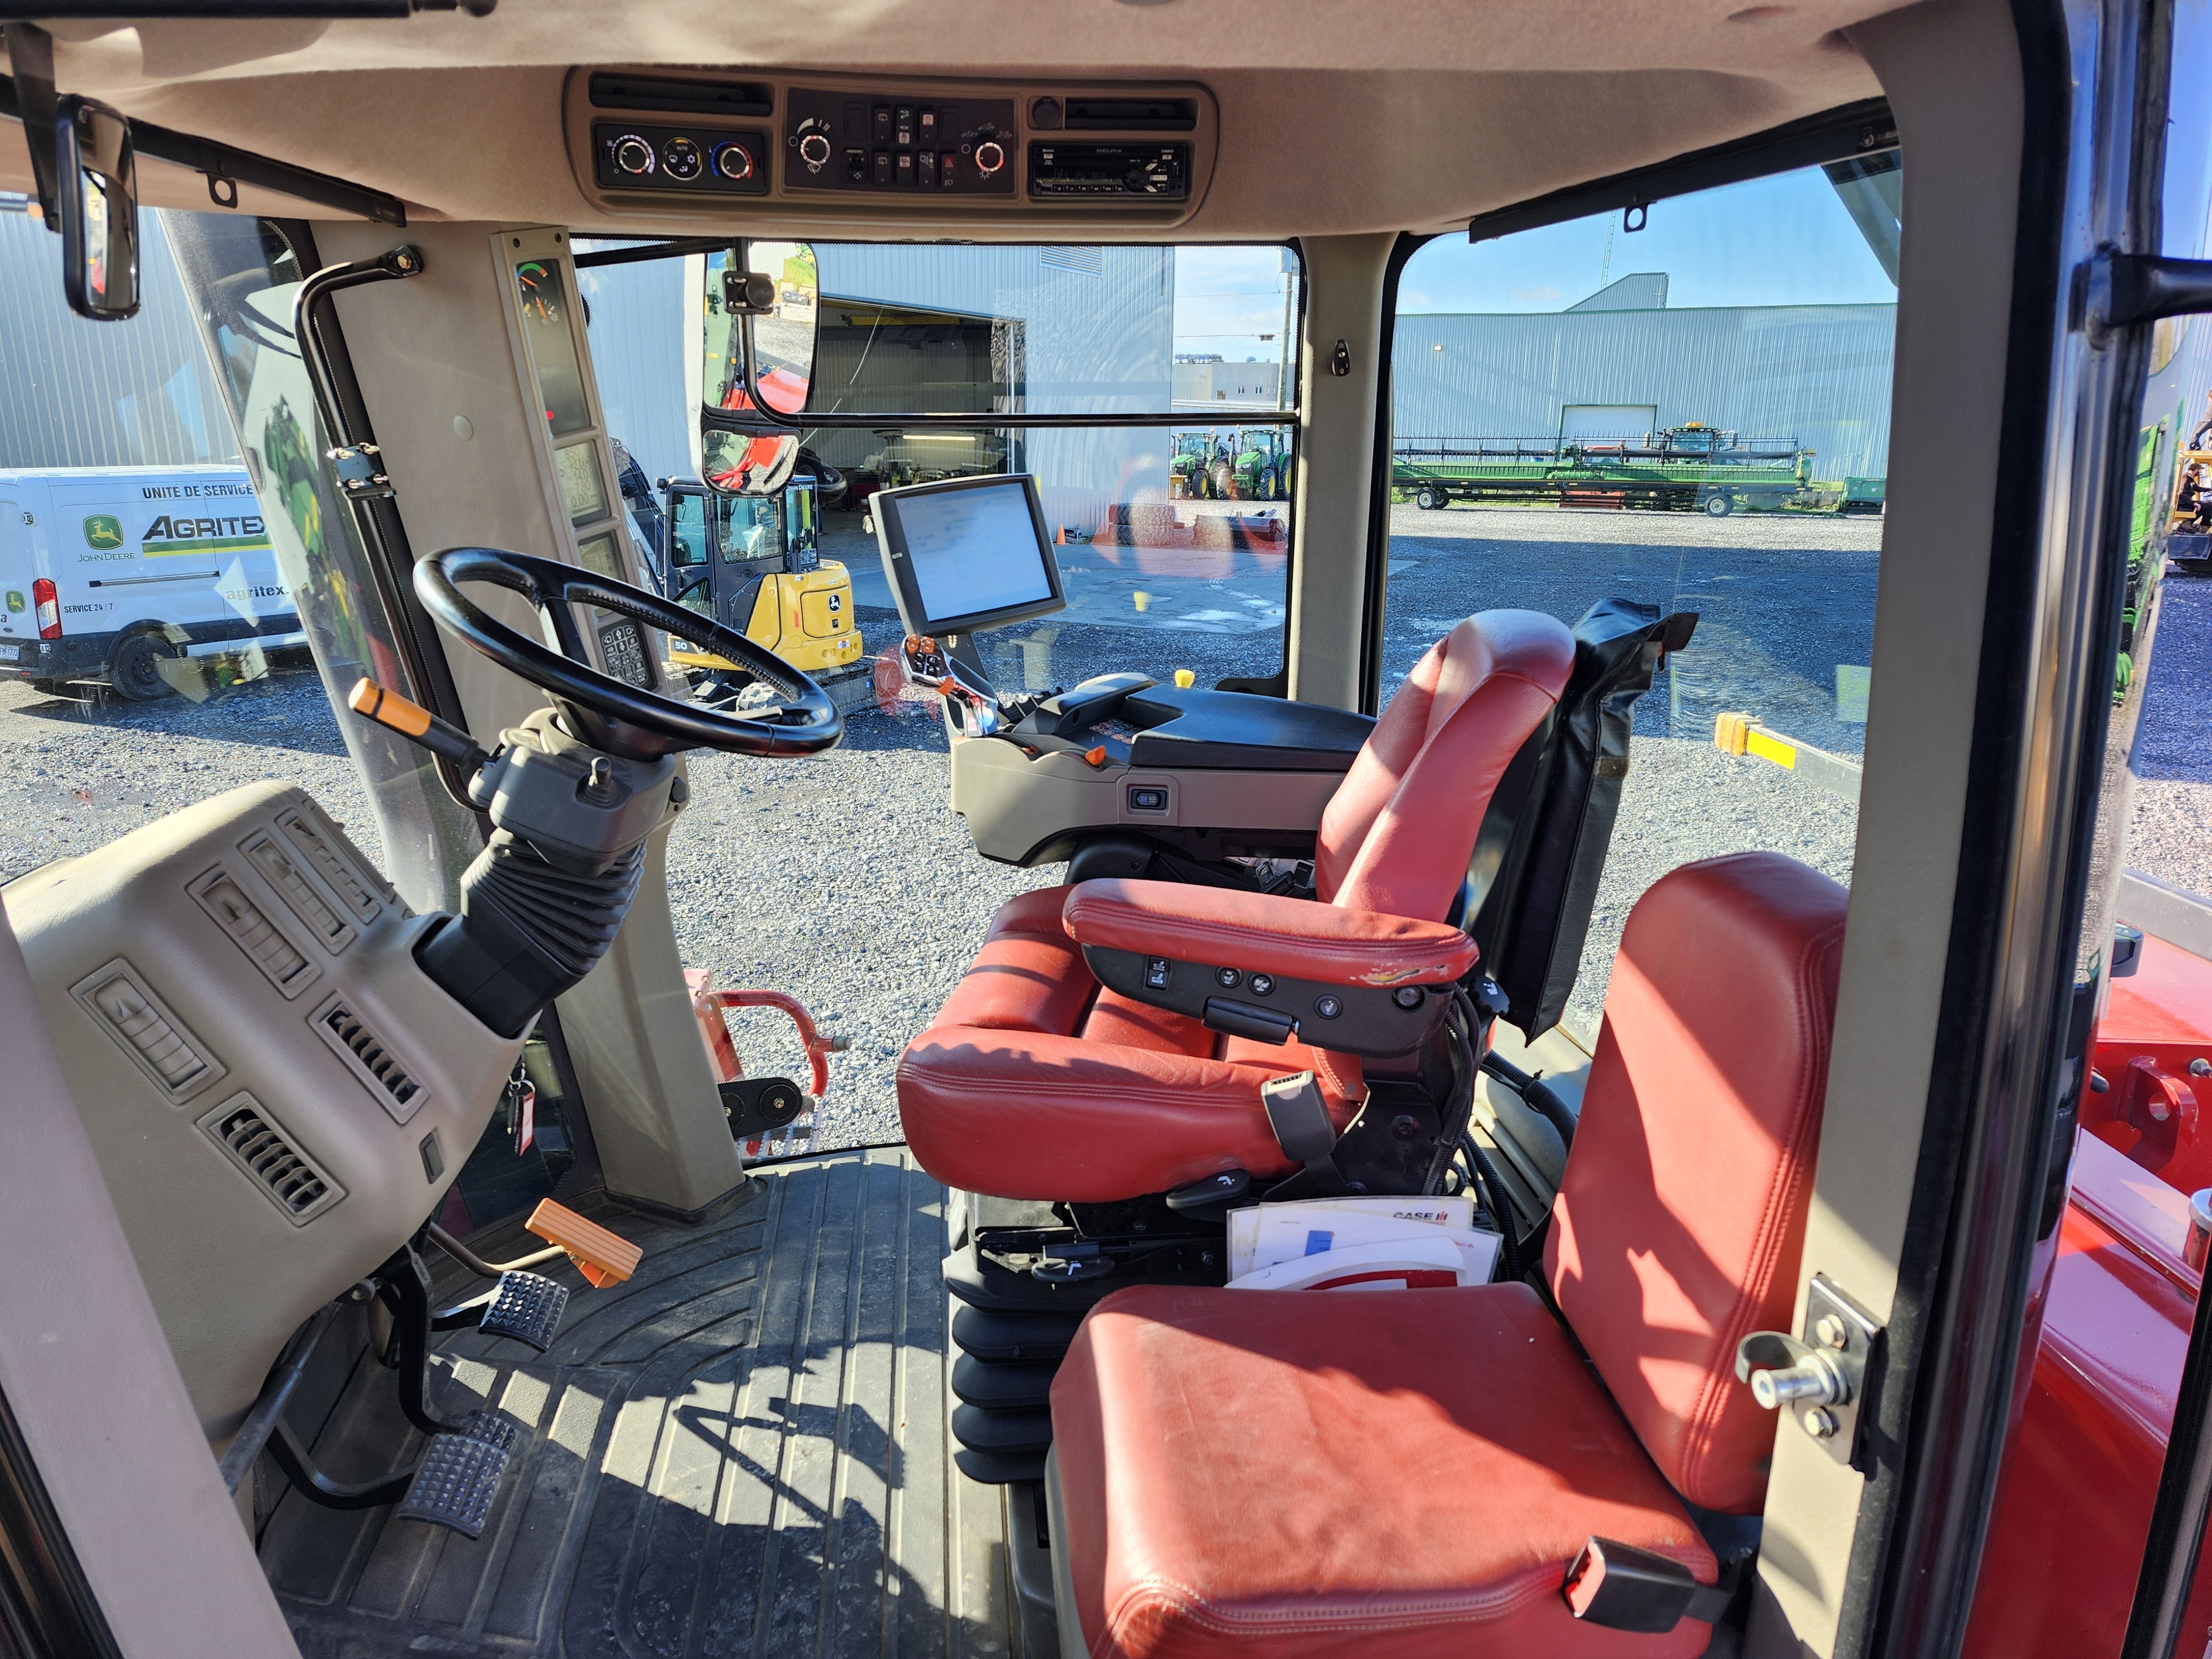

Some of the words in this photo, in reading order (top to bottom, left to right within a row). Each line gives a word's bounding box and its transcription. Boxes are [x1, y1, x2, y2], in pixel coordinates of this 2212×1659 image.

[142, 484, 181, 499] UNITÉ
[184, 486, 201, 497] DE
[204, 484, 254, 497] SERVICE
[77, 554, 104, 562] JOHN
[104, 552, 136, 561] DEERE
[64, 604, 93, 613] SERVICE
[675, 641, 687, 650] 50
[1393, 1212, 1434, 1220] CASE
